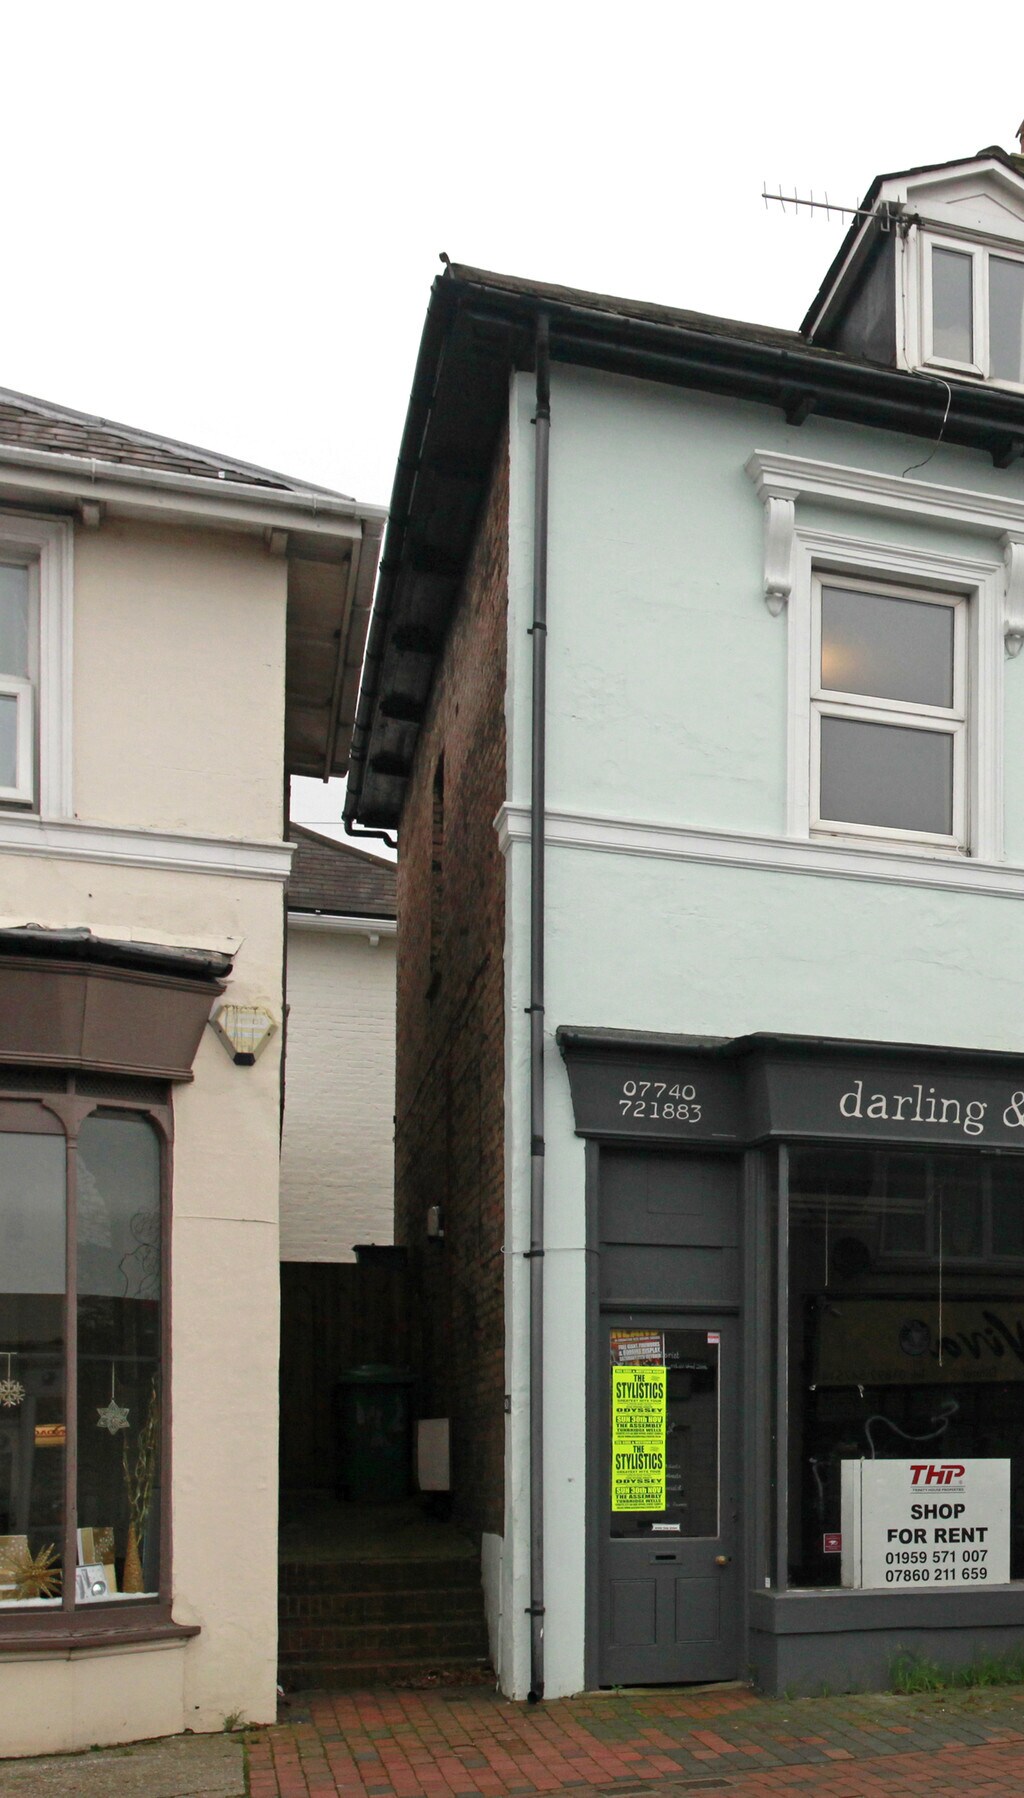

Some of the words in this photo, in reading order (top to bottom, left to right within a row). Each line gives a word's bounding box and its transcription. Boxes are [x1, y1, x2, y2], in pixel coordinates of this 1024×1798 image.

[622, 1080, 697, 1101] 07740
[618, 1099, 703, 1124] 721883
[838, 1080, 989, 1136] darling
[634, 1374, 645, 1382] THE
[616, 1382, 664, 1399] STYLISTICS
[633, 1445, 644, 1453] THE
[615, 1453, 663, 1470] STYLISTICS
[909, 1464, 967, 1485] THP
[910, 1503, 966, 1521] SHOP
[887, 1528, 928, 1545] FOR
[934, 1527, 989, 1544] RENT
[885, 1551, 928, 1565] 01959
[932, 1550, 956, 1563] 571
[962, 1549, 989, 1563] 007
[885, 1568, 930, 1583] 07860
[934, 1568, 956, 1581] 211
[961, 1567, 988, 1580] 659
